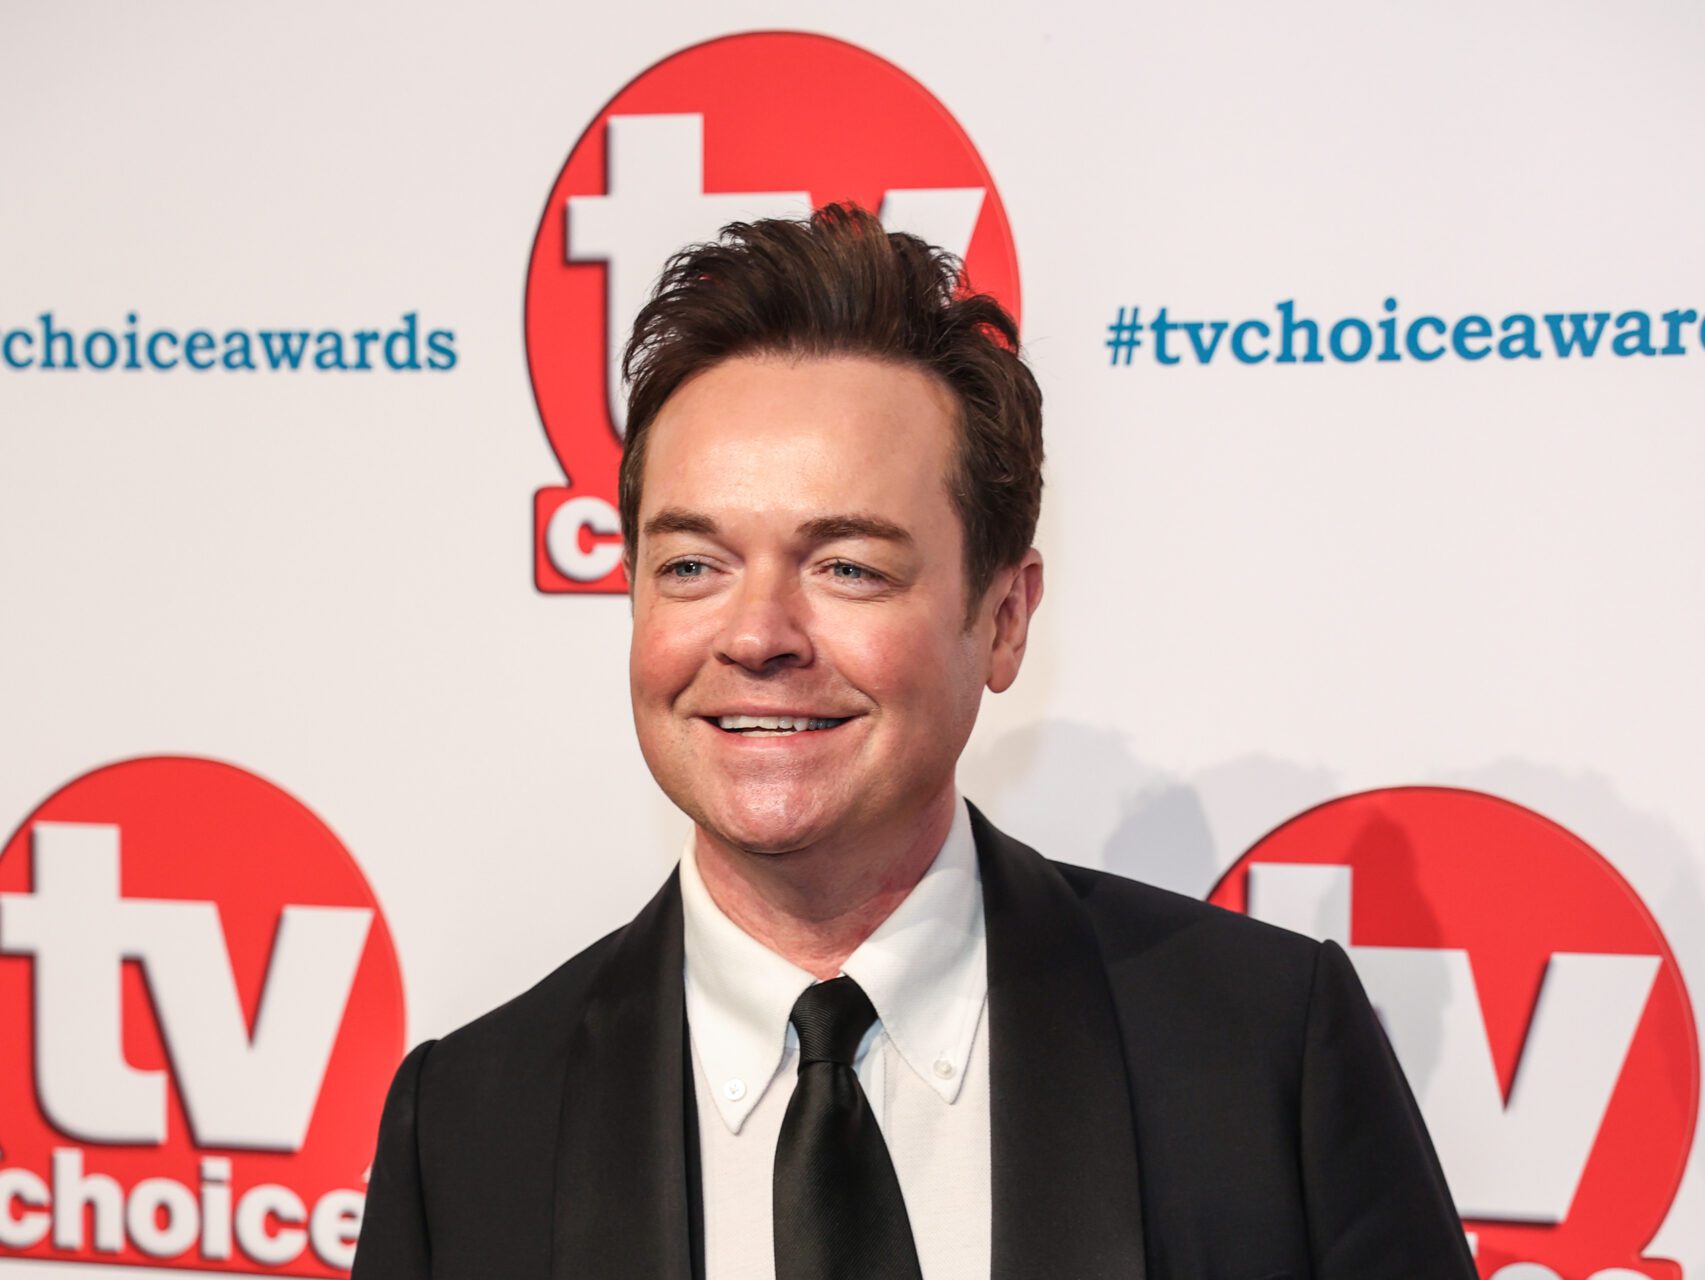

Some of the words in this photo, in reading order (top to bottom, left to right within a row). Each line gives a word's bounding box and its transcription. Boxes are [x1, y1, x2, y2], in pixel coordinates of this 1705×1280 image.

[1105, 298, 1705, 366] #tvchoiceawar
[0, 820, 375, 1151] tv
[0, 1148, 367, 1269] choice
